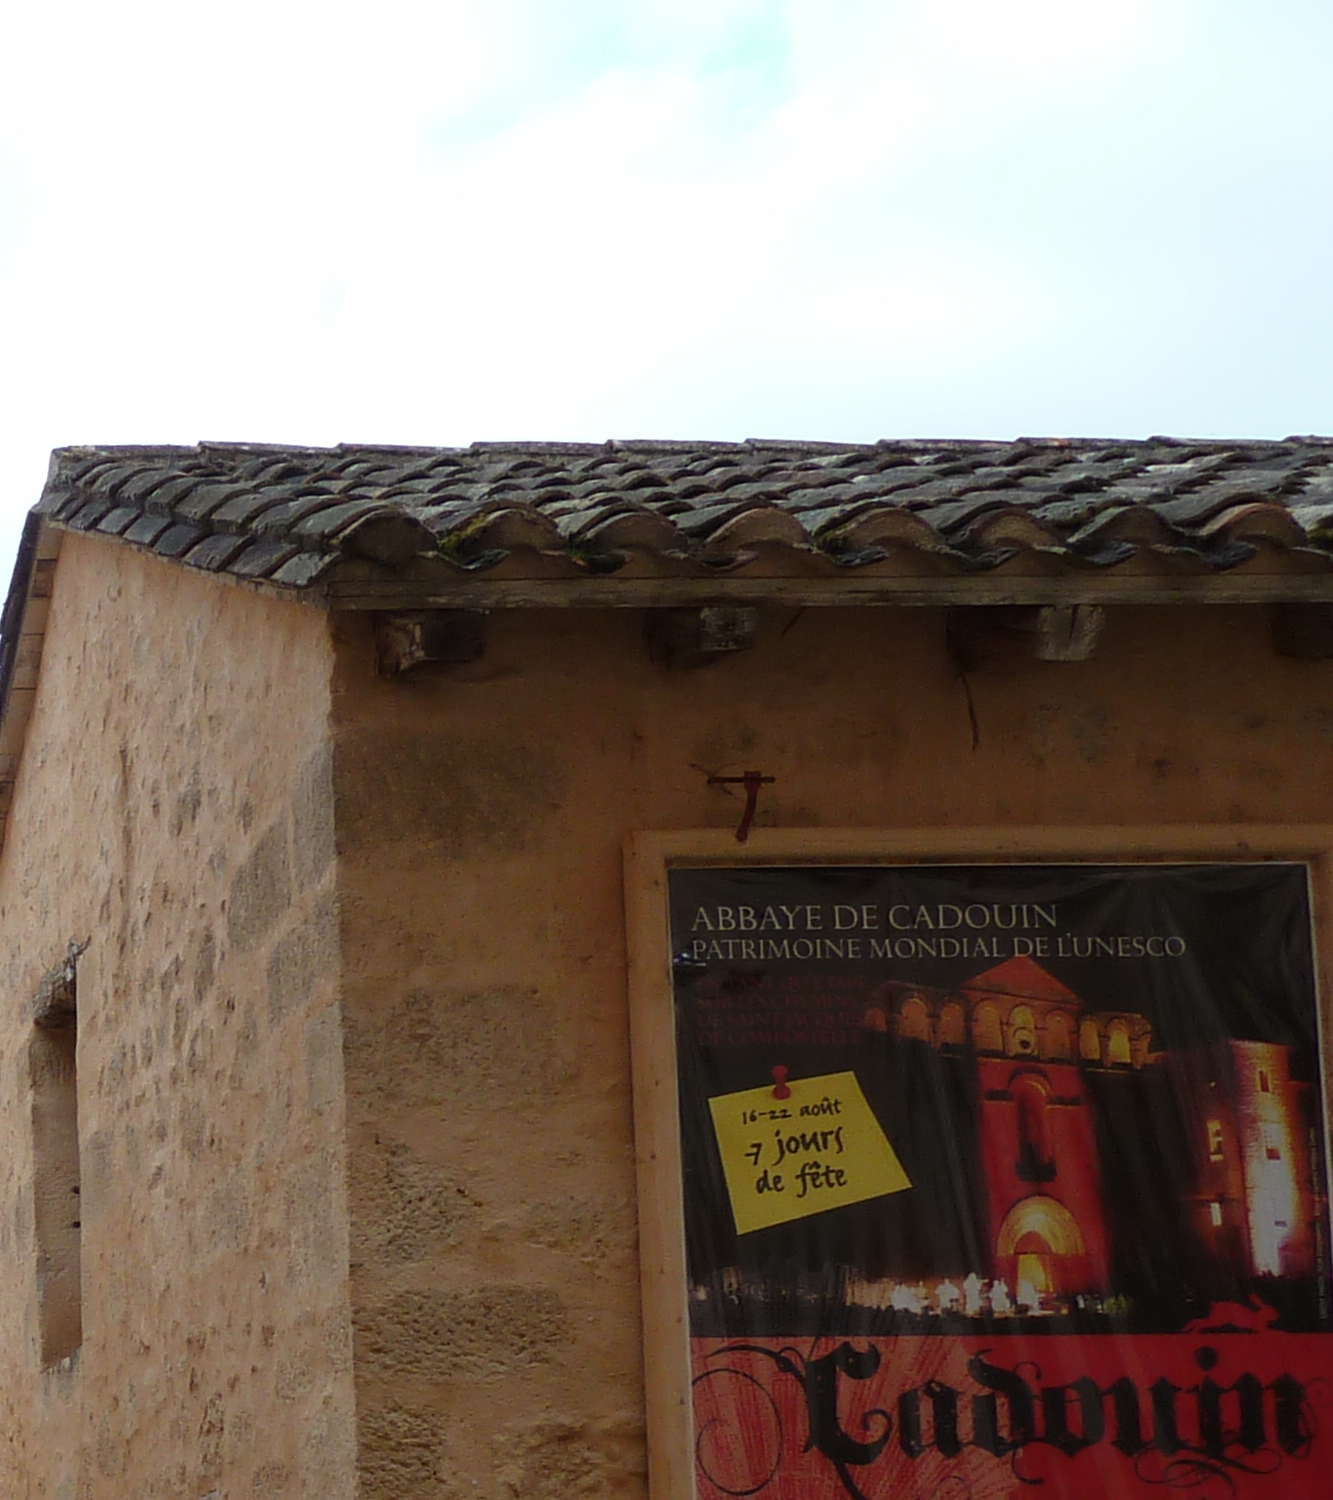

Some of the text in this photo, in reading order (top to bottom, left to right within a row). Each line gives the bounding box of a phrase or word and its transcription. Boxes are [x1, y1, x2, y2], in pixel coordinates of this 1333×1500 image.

[691, 902, 1059, 933] ABBAYE DE CADOUIN
[691, 933, 1187, 961] PATRIMOINE MONDIAL DE L'UNESCO
[741, 1097, 843, 1125] 16-22 août
[743, 1125, 847, 1166] 7 jours
[755, 1162, 849, 1201] de fête
